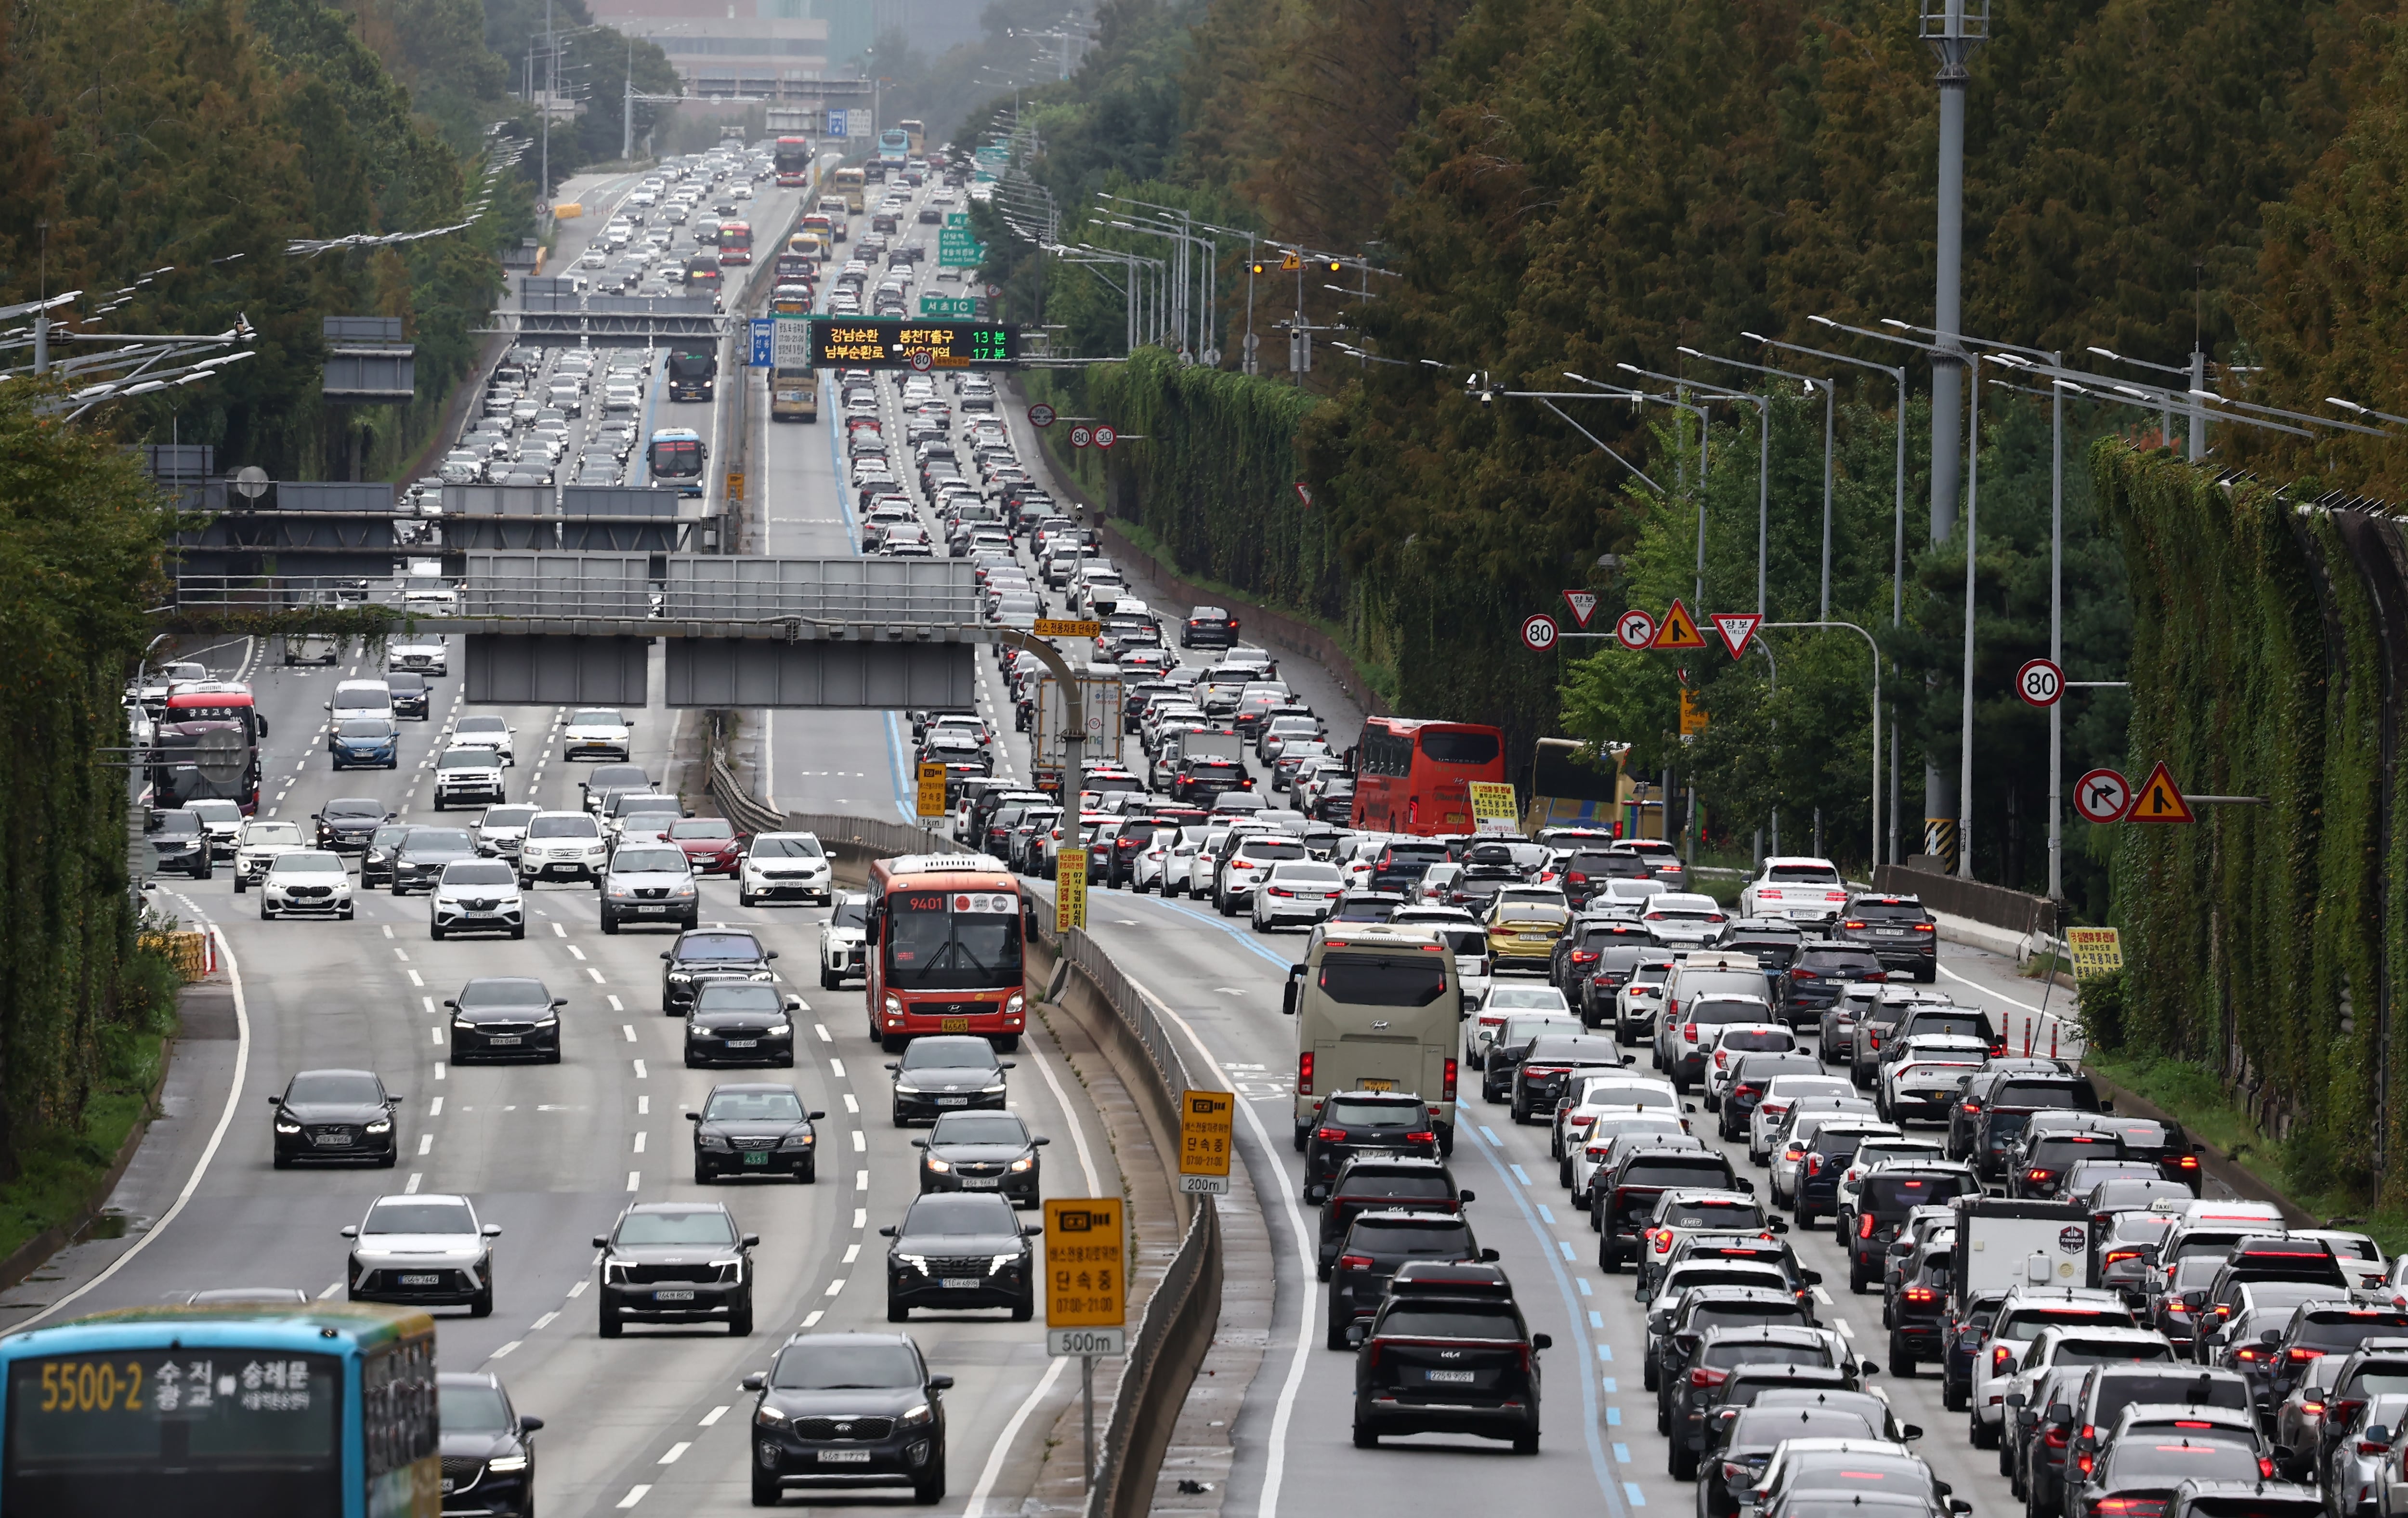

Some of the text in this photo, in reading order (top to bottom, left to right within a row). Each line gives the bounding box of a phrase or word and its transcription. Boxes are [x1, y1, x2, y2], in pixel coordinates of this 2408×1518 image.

[830, 327, 1006, 345] 강남순환 봉천T출구 13 분
[824, 345, 885, 360] 남부순환로
[973, 348, 989, 359] 17
[915, 354, 929, 365] 80
[1074, 432, 1088, 443] 80
[1099, 431, 1112, 440] 30
[1574, 595, 1595, 603] 양보
[1035, 622, 1099, 636] 버스 전용차로 단속중
[1725, 619, 1749, 629] 양보
[1529, 625, 1551, 641] 80
[2027, 672, 2056, 695] 80
[189, 707, 233, 717] 금호고속
[1054, 734, 1103, 745] cong
[921, 792, 941, 801] 단속중
[1474, 799, 1514, 808] 버스전용차로
[922, 818, 940, 826] 1km
[1060, 872, 1070, 887] 명절
[910, 897, 943, 910] 9401
[1060, 903, 1070, 912] 및
[2070, 932, 2115, 943] 명절연휴 및 전날
[2074, 953, 2120, 965] 버스전용차로
[1184, 1122, 1229, 1133] 버스전용차로위반
[1187, 1137, 1223, 1152] 단속중
[1188, 1178, 1219, 1191] 200m
[1049, 1246, 1118, 1263] 버스전용차로위반
[1056, 1269, 1112, 1292] 단속중
[1061, 1334, 1111, 1352] 500m
[1440, 1350, 1461, 1359] KIA
[155, 1360, 213, 1385] 수지
[41, 1361, 143, 1412] 5500-2
[155, 1385, 214, 1411] 광교
